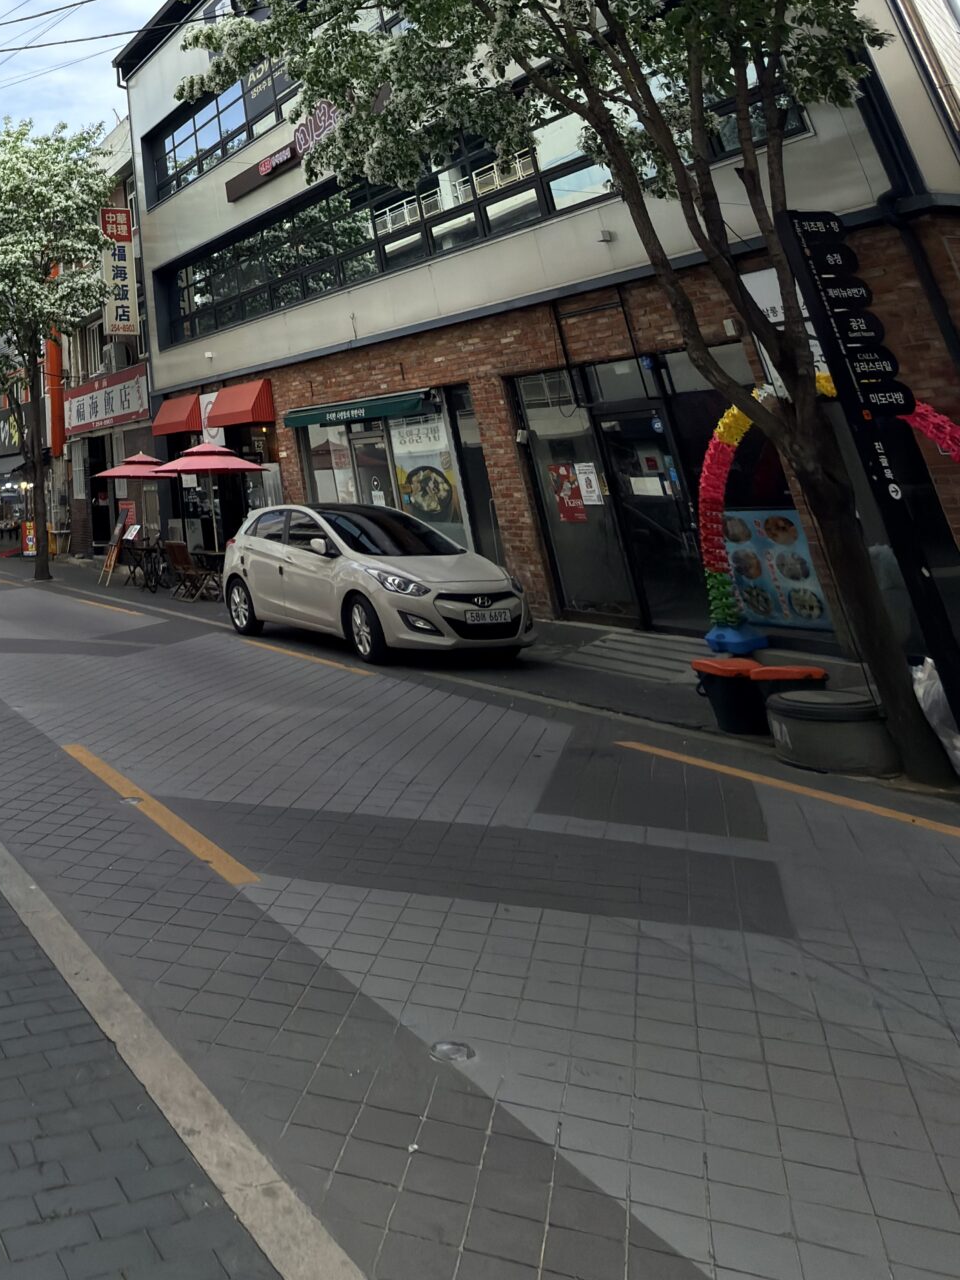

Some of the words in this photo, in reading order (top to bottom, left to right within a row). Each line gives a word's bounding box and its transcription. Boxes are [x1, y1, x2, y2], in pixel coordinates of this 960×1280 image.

[111, 245, 130, 322] 福海飯店
[76, 384, 131, 423] 福海飯店
[869, 392, 905, 405] 미도다방
